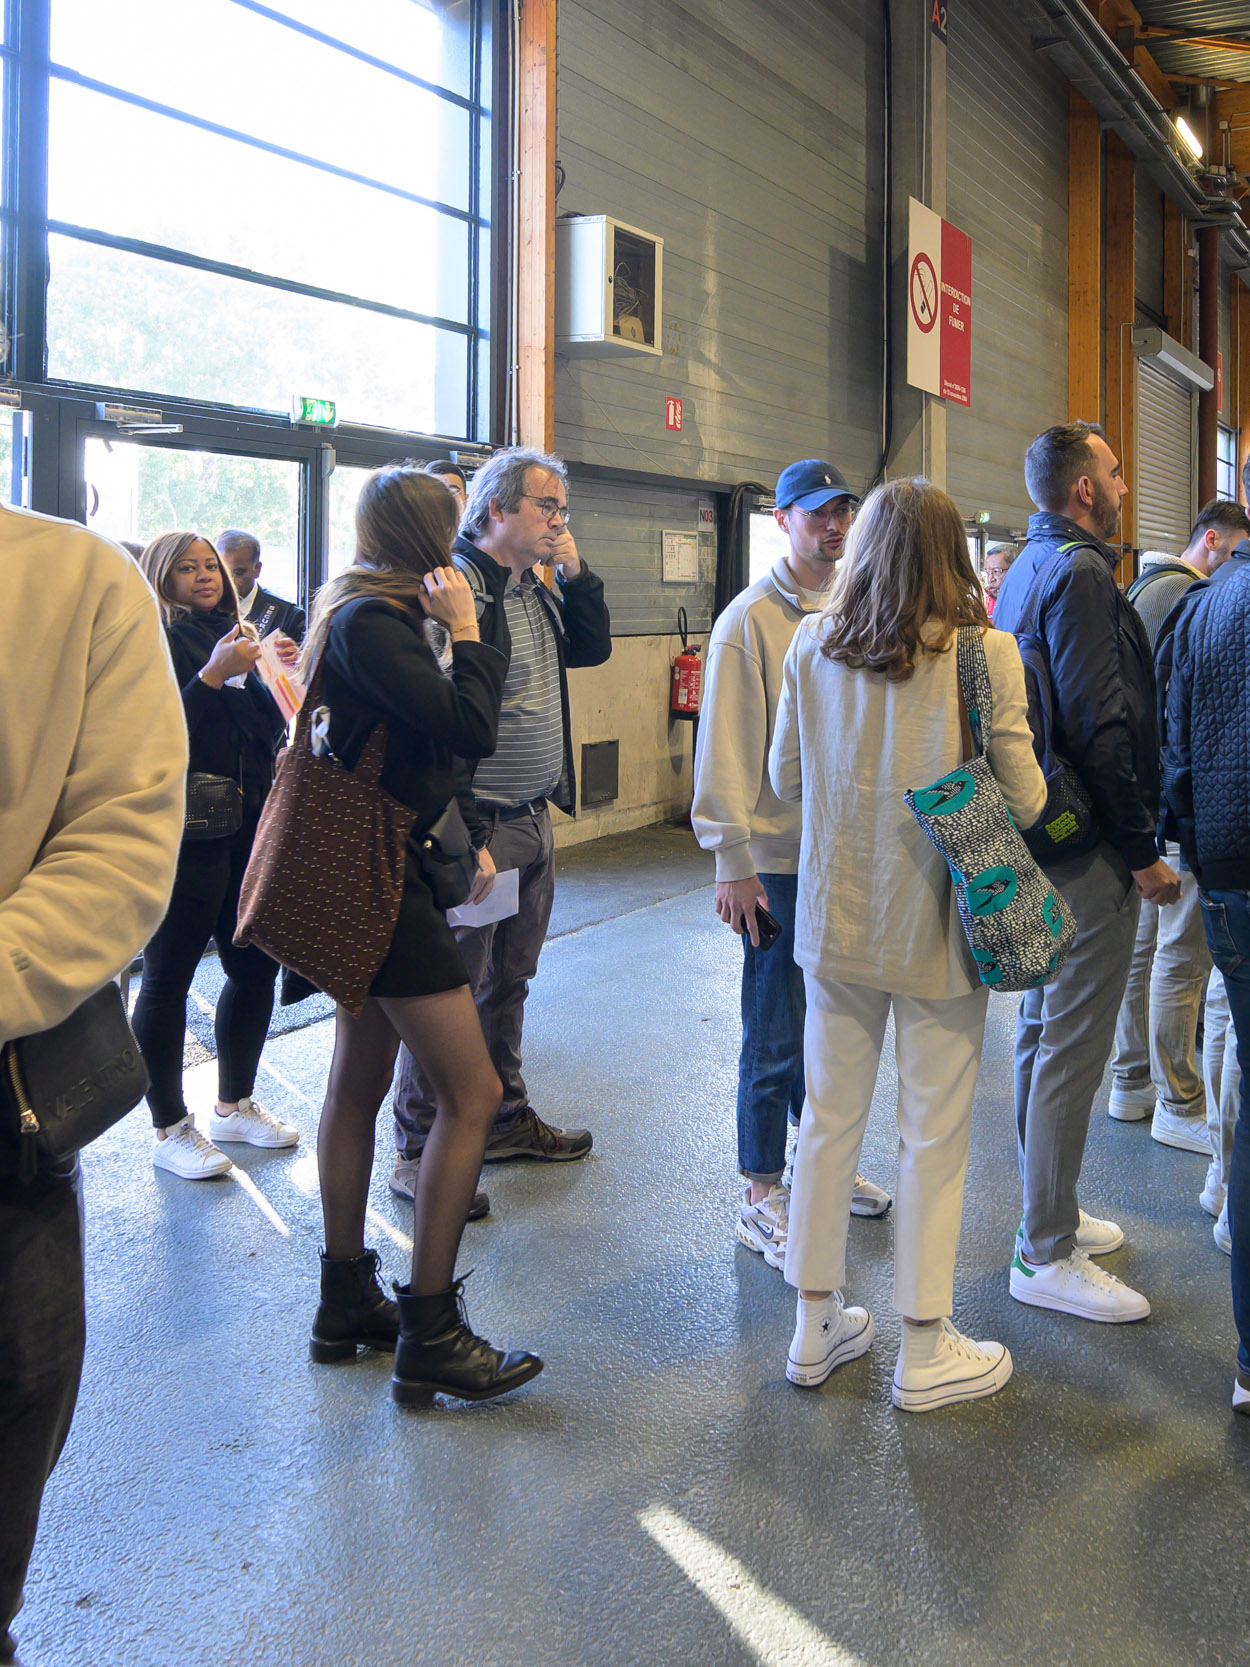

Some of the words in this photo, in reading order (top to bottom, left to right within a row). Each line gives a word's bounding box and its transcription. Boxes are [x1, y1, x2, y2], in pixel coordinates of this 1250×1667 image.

[952, 302, 960, 315] DE
[948, 315, 965, 332] FUMER
[700, 509, 713, 522] N03
